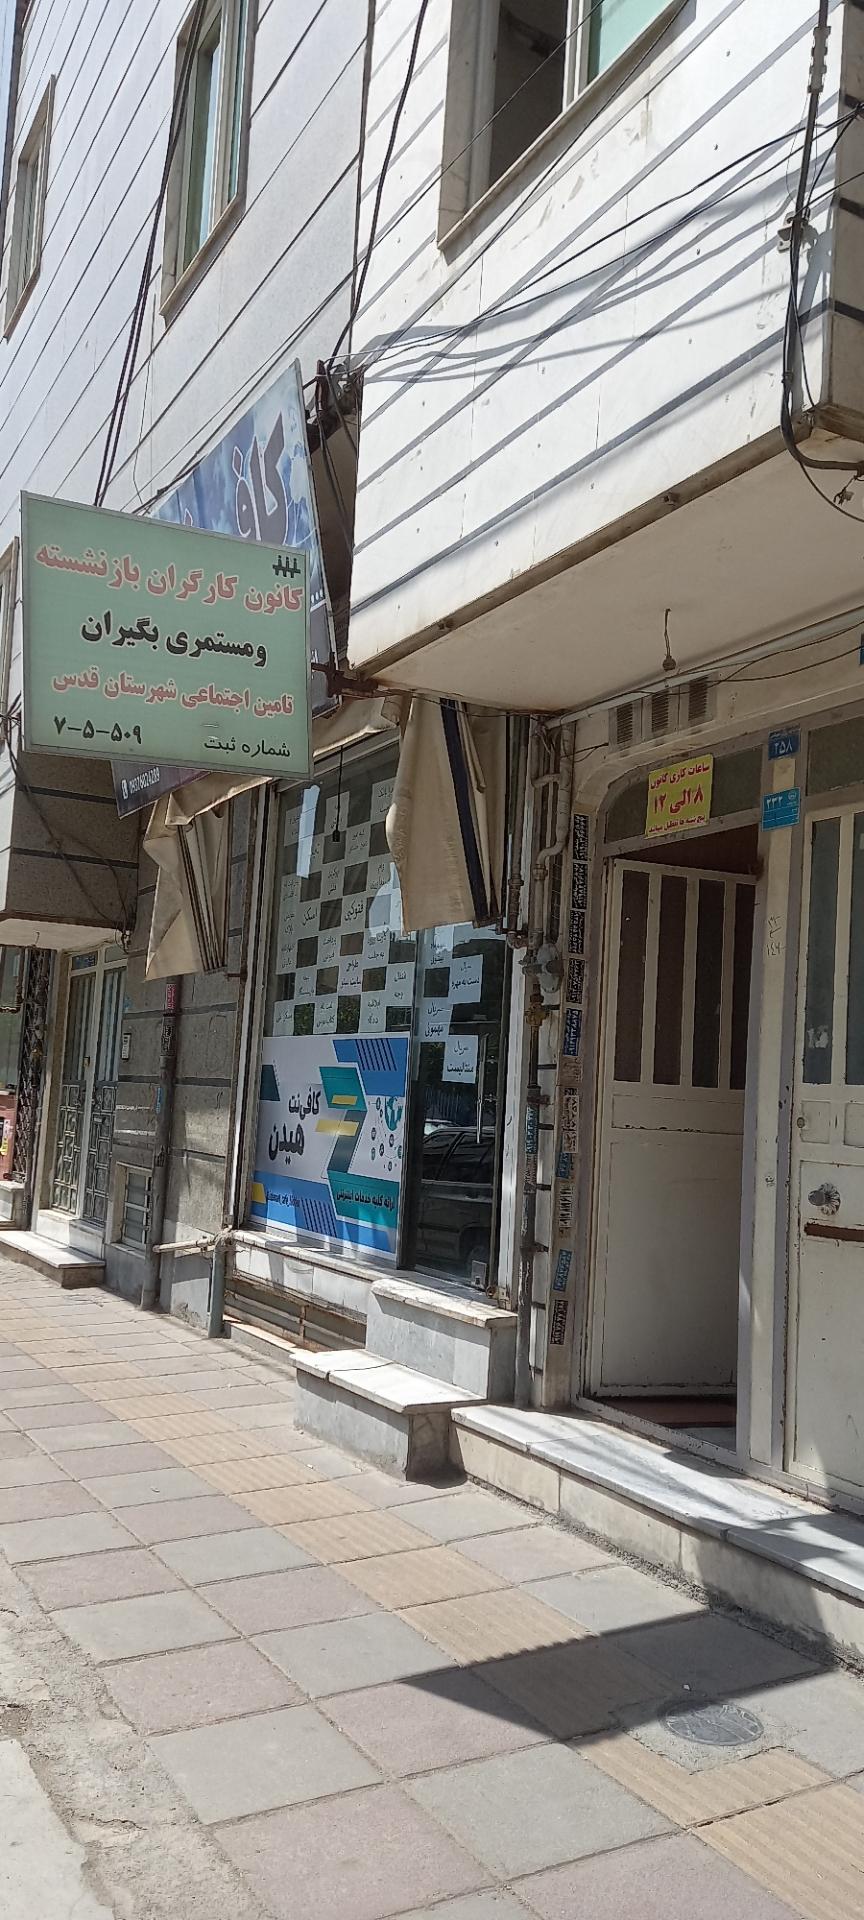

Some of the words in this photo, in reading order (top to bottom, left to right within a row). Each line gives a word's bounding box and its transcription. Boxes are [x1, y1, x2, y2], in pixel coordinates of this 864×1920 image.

[35, 546, 141, 590] بازنشسته
[147, 564, 238, 604] کارگران
[244, 583, 304, 614] کانون
[80, 610, 160, 651] بگیران
[52, 666, 100, 692] قدس
[103, 672, 177, 704] شهرستان
[181, 683, 250, 714] اجتماعی
[253, 693, 294, 717] تامین
[203, 736, 237, 753] ثبت
[242, 740, 291, 758] شماره
[650, 772, 668, 789] کانون
[669, 767, 687, 784] کاری
[687, 762, 710, 776] ساعات
[654, 793, 667, 814] ۱۲
[669, 787, 692, 814] الی
[693, 783, 704, 804] ۸
[268, 1123, 305, 1165] هیدن
